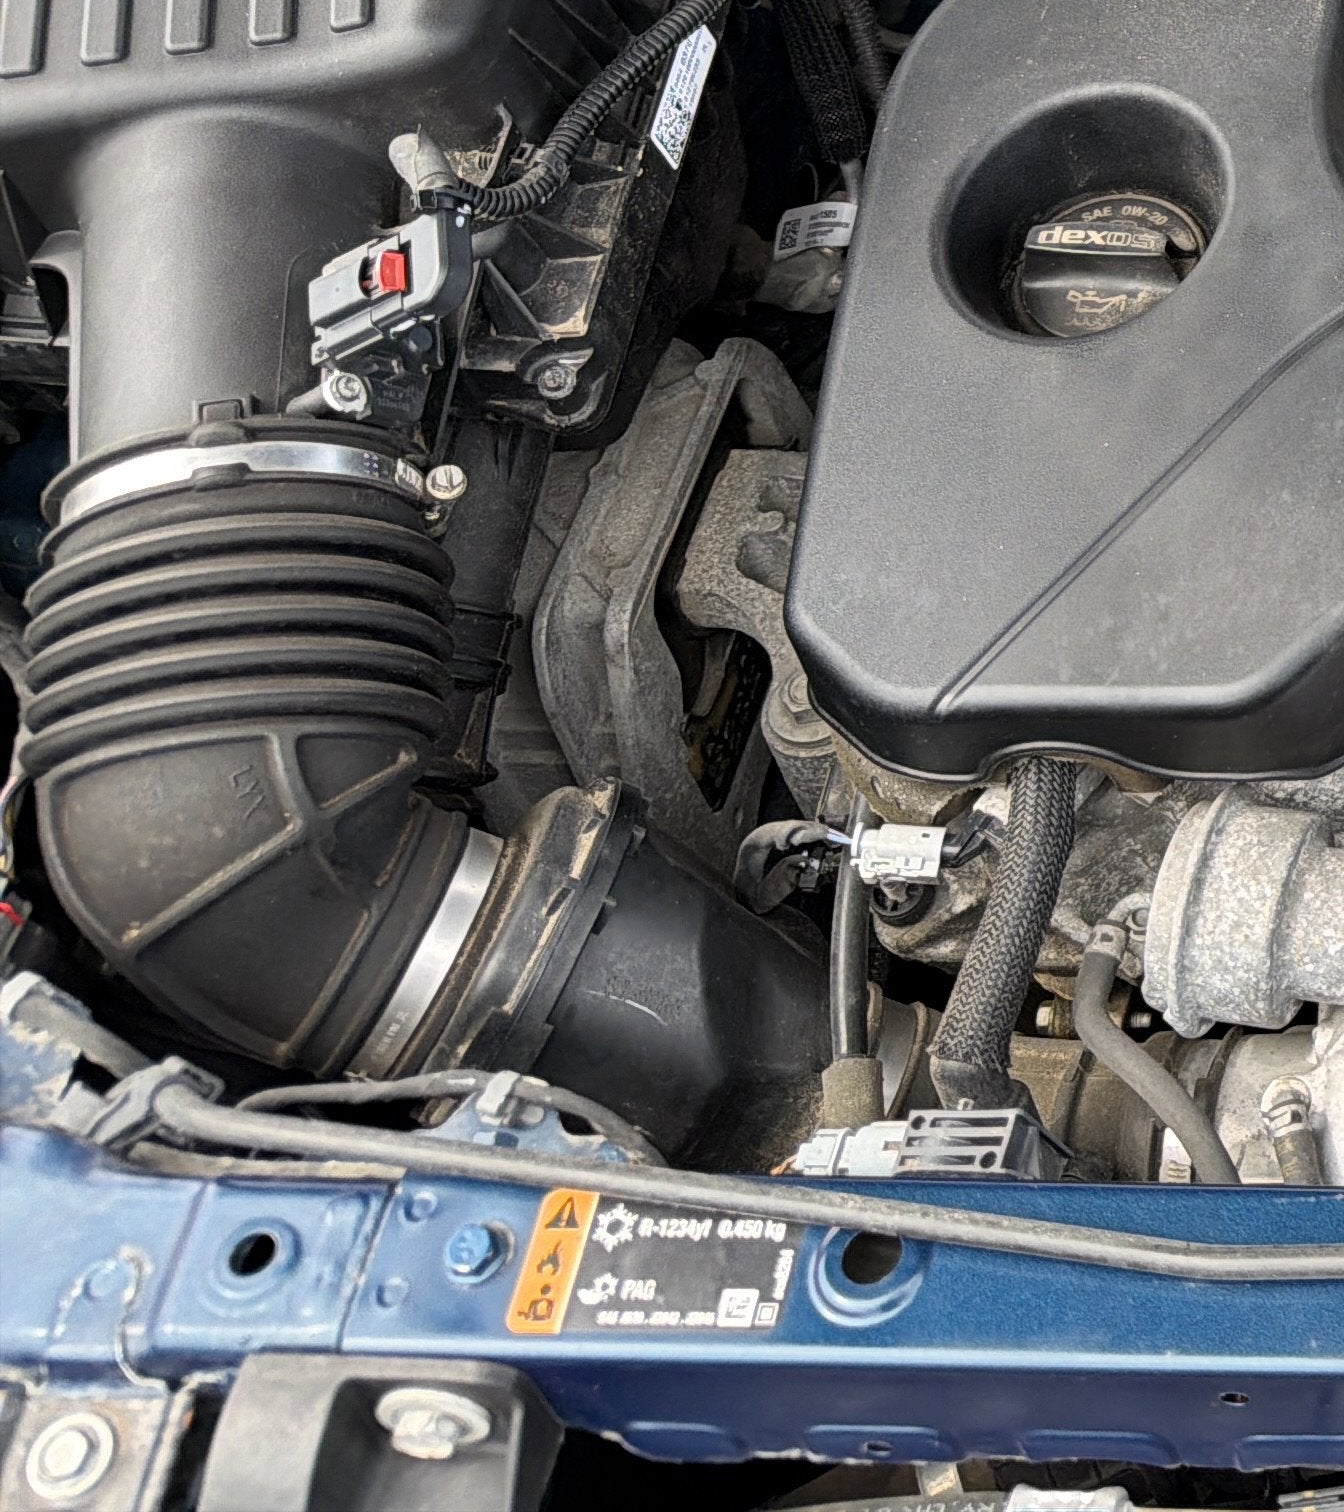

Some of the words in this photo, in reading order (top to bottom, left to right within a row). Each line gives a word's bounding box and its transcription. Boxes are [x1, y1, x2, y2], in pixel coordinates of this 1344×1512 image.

[1081, 206, 1113, 223] SAE
[1121, 204, 1169, 226] 0W-20
[1037, 226, 1157, 249] dexos
[638, 1217, 713, 1242] R-1234yf
[717, 1218, 763, 1239] 0.450
[764, 1219, 786, 1243] kg
[621, 1279, 657, 1301] PAG
